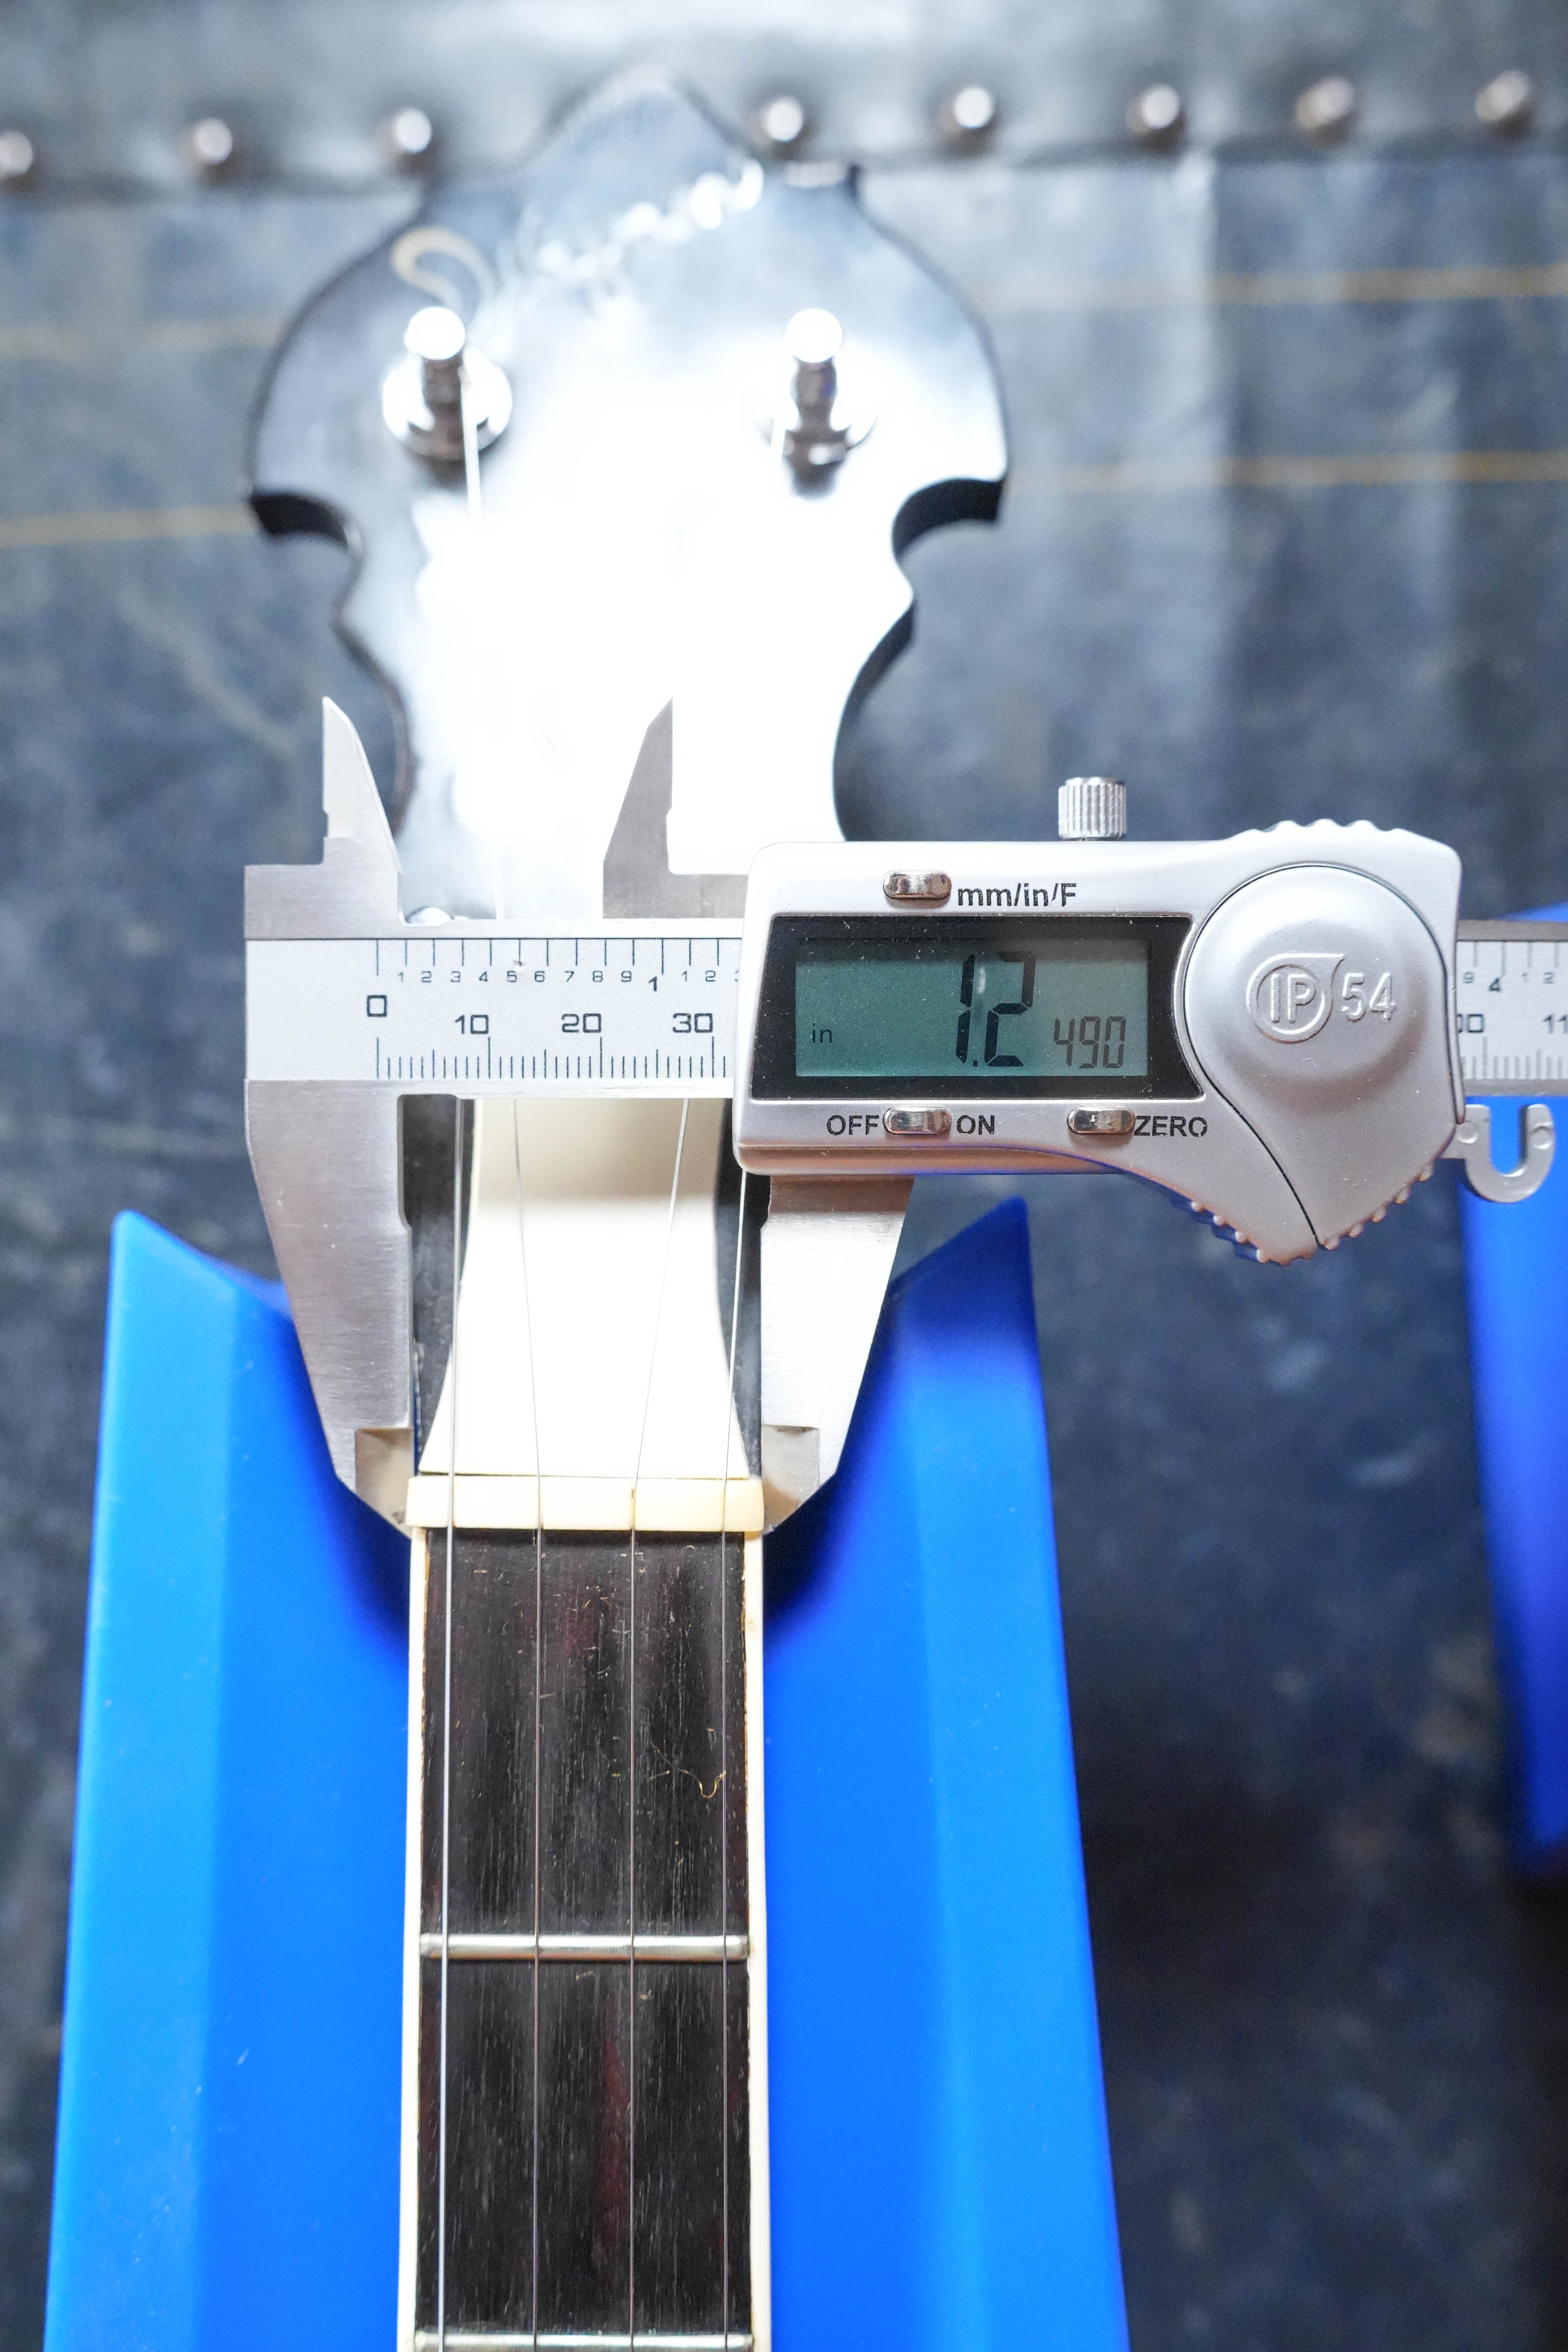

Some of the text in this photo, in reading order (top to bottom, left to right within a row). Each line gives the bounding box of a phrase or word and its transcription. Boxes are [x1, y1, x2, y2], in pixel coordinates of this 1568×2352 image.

[958, 883, 1077, 907] mm/in/F
[397, 970, 716, 992] 1 2 3 4 5 6 7 8 9 1 1 2
[1488, 977, 1502, 993] 4
[1543, 971, 1555, 984] 2
[366, 994, 388, 1018] 0
[1269, 972, 1396, 1023] IP 54
[454, 1012, 714, 1035] 10 20 30
[812, 1022, 832, 1044] in
[826, 1114, 1208, 1138] OFF ON ZERO
